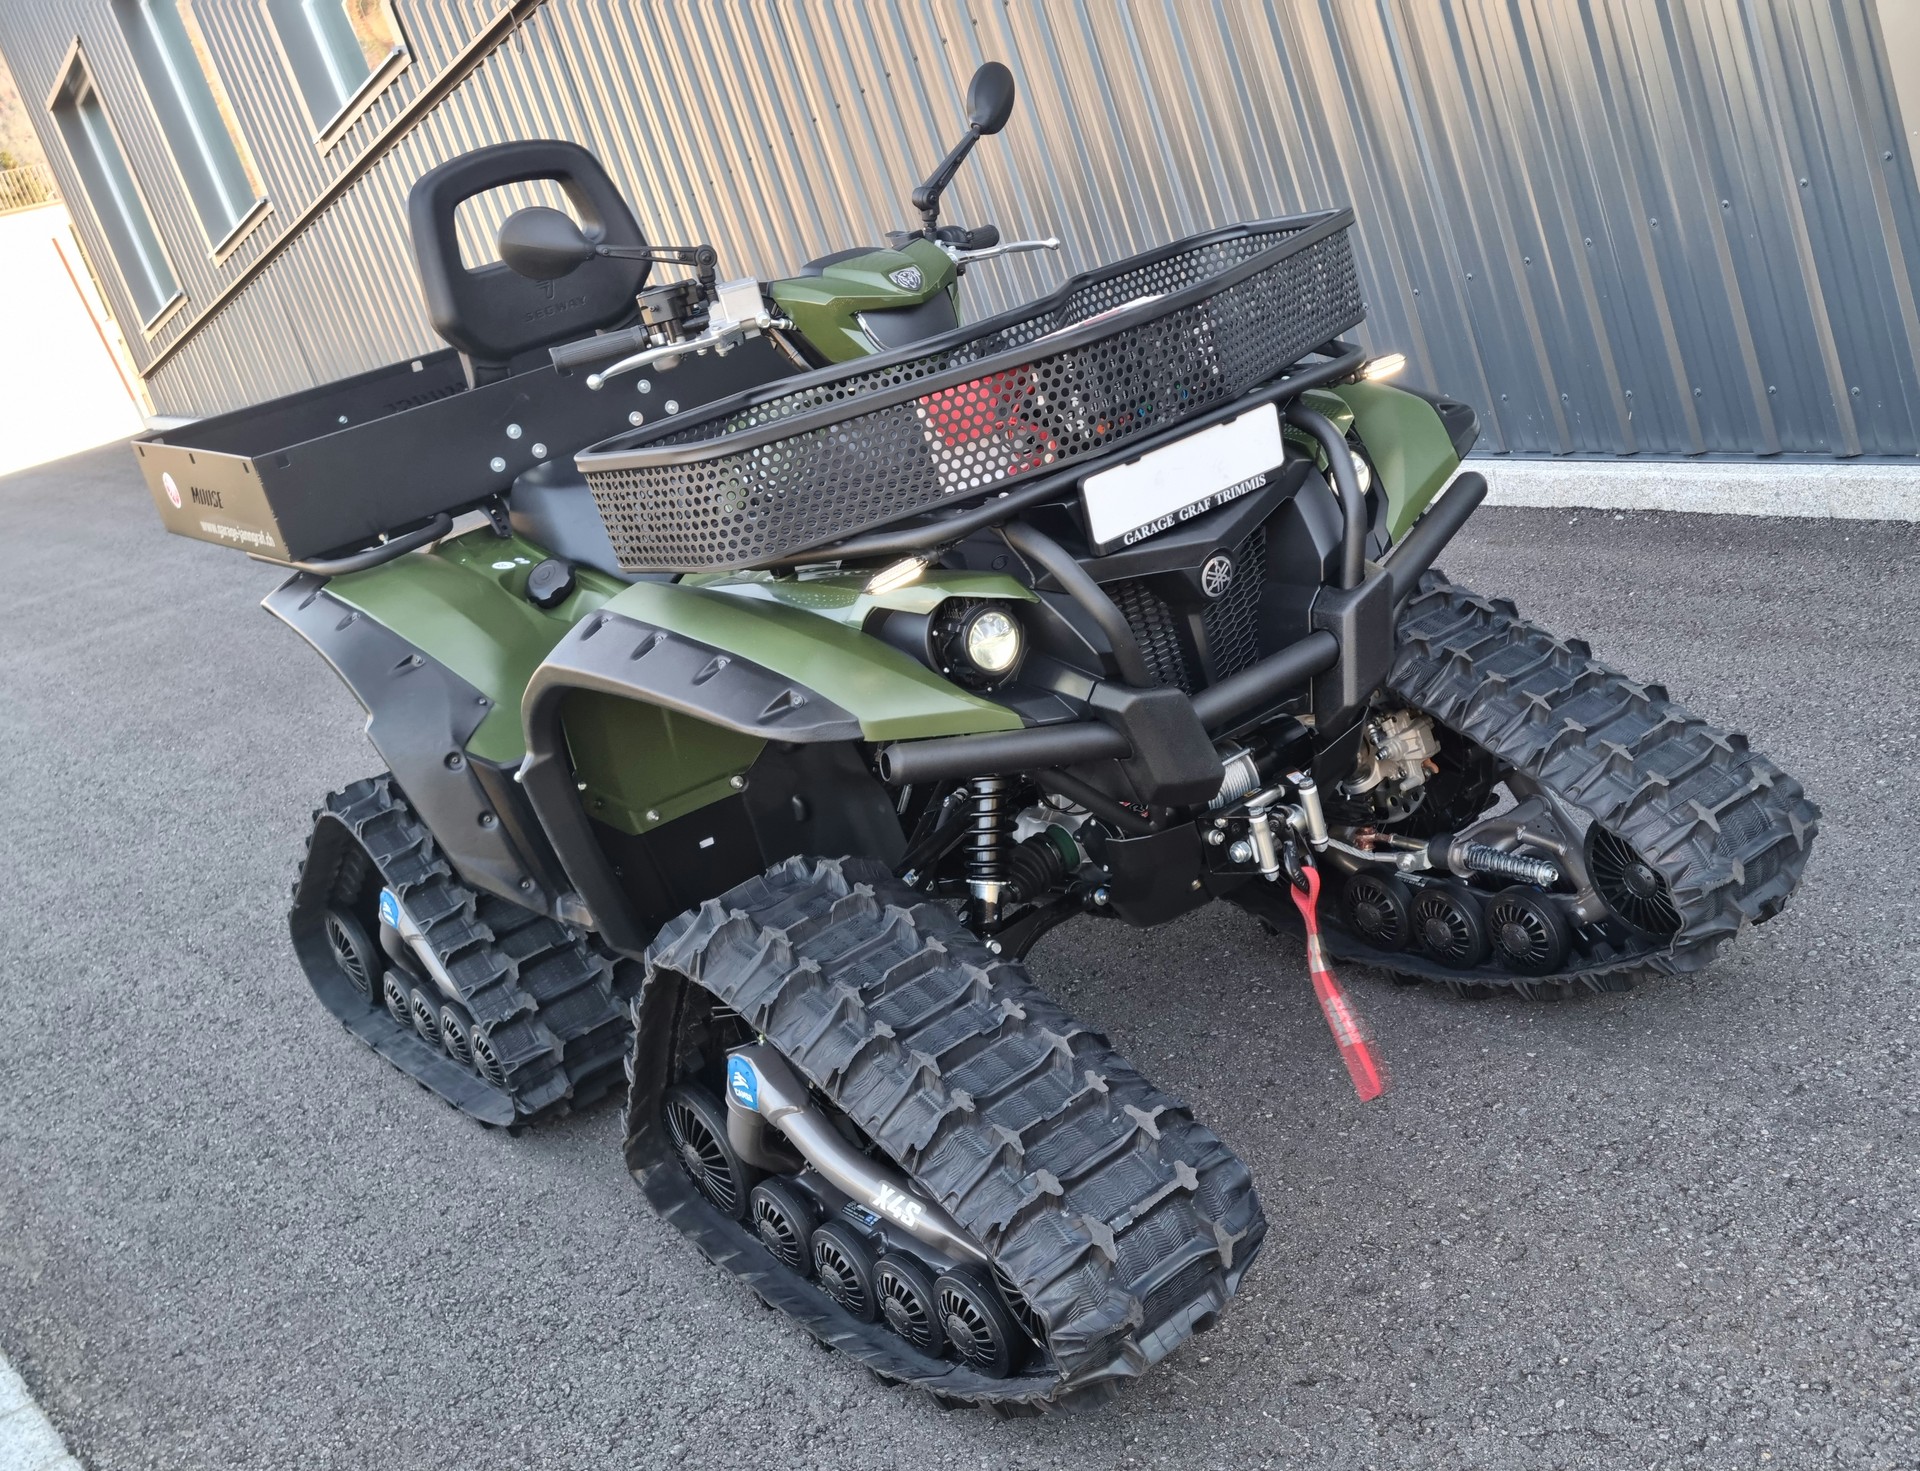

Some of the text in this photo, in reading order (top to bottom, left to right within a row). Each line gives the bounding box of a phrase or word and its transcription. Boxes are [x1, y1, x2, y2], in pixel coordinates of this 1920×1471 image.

[525, 295, 587, 323] SEGWAY
[1123, 474, 1267, 546] GARAGE GRAF TRIMMIS
[873, 1183, 922, 1227] X4S
